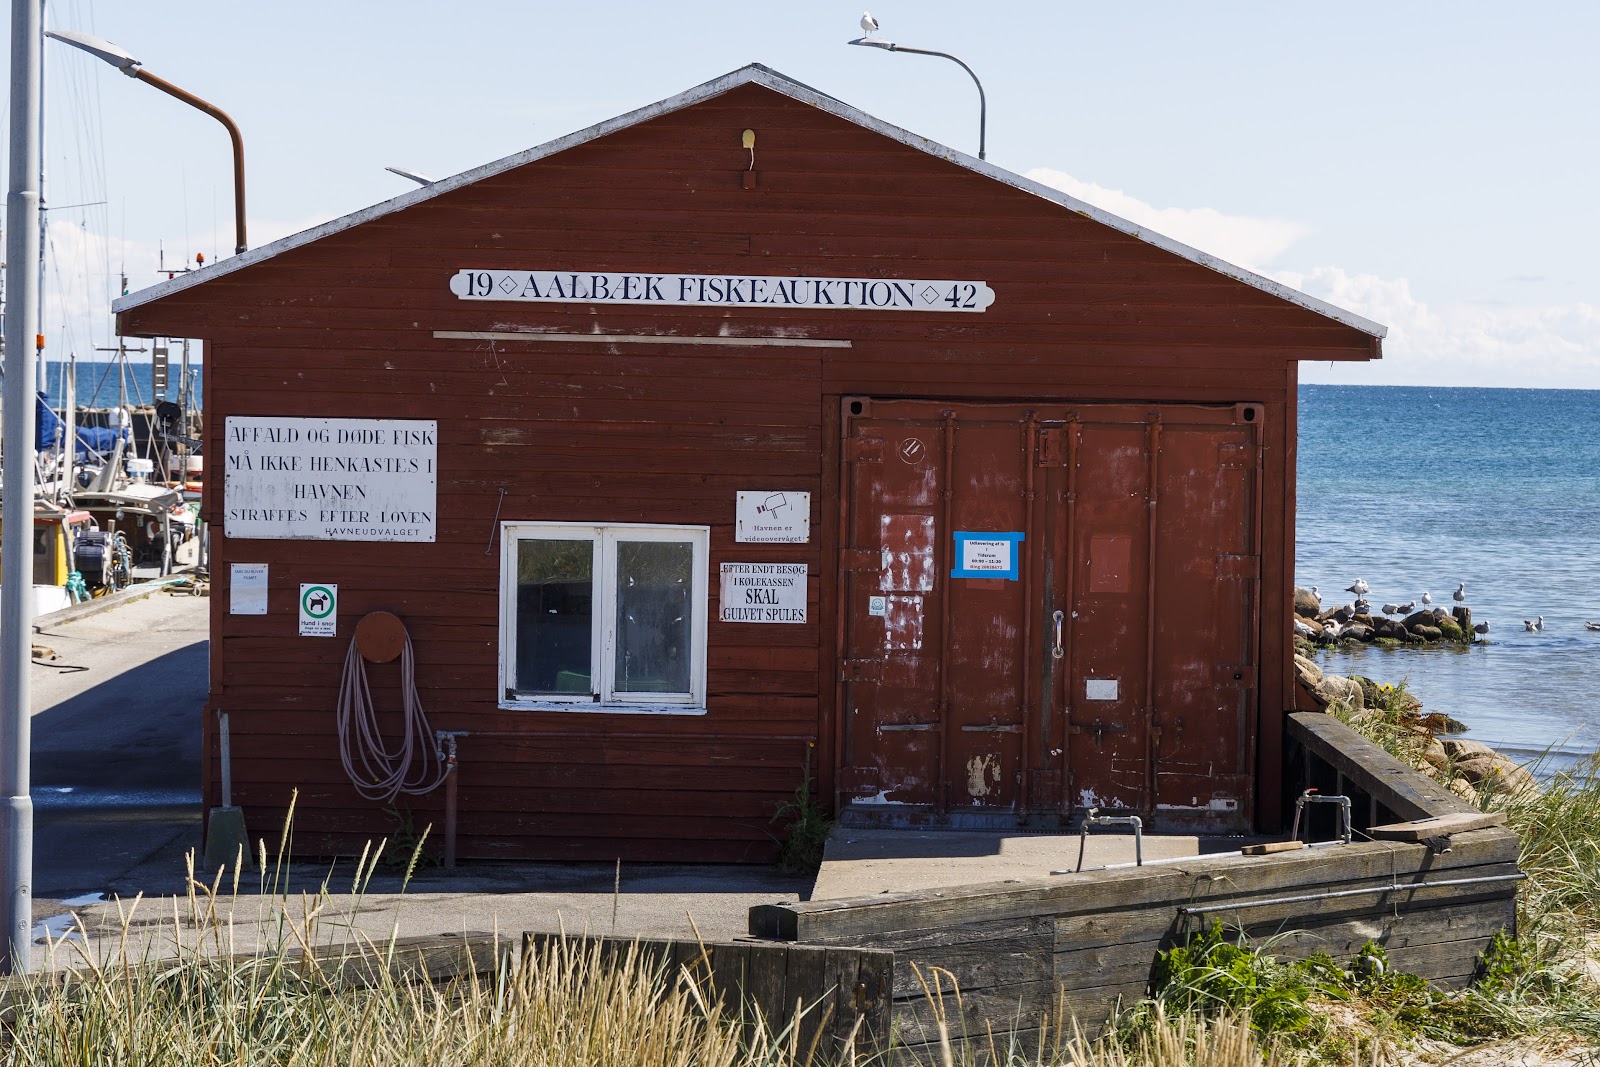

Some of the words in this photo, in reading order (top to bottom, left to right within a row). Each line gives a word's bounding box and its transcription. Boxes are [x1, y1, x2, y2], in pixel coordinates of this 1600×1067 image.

[466, 272, 493, 297] 19
[519, 274, 665, 301] AALBÆK
[677, 277, 916, 307] FISKEAUKTION
[944, 284, 977, 309] 42
[228, 426, 299, 444] AFFALD
[308, 428, 330, 444] OG
[337, 429, 386, 445] DØDE
[392, 430, 434, 446] FISK
[228, 450, 253, 471] MÅ
[260, 456, 302, 472] IKKE
[310, 456, 419, 474] HENKASTES
[426, 458, 432, 474] I
[294, 484, 367, 500] HAVNEN
[229, 508, 308, 522] STRAFFES
[320, 510, 369, 523] EFTER
[325, 528, 420, 536] HAVNEUDVALGET
[723, 564, 750, 574] EFTER
[752, 565, 774, 574] ENDT
[776, 565, 805, 574] BESØG
[739, 578, 794, 586] KØLEKASSEN
[745, 588, 780, 605] SKAL
[724, 608, 764, 621] GULVET
[766, 608, 804, 622] SPULES
